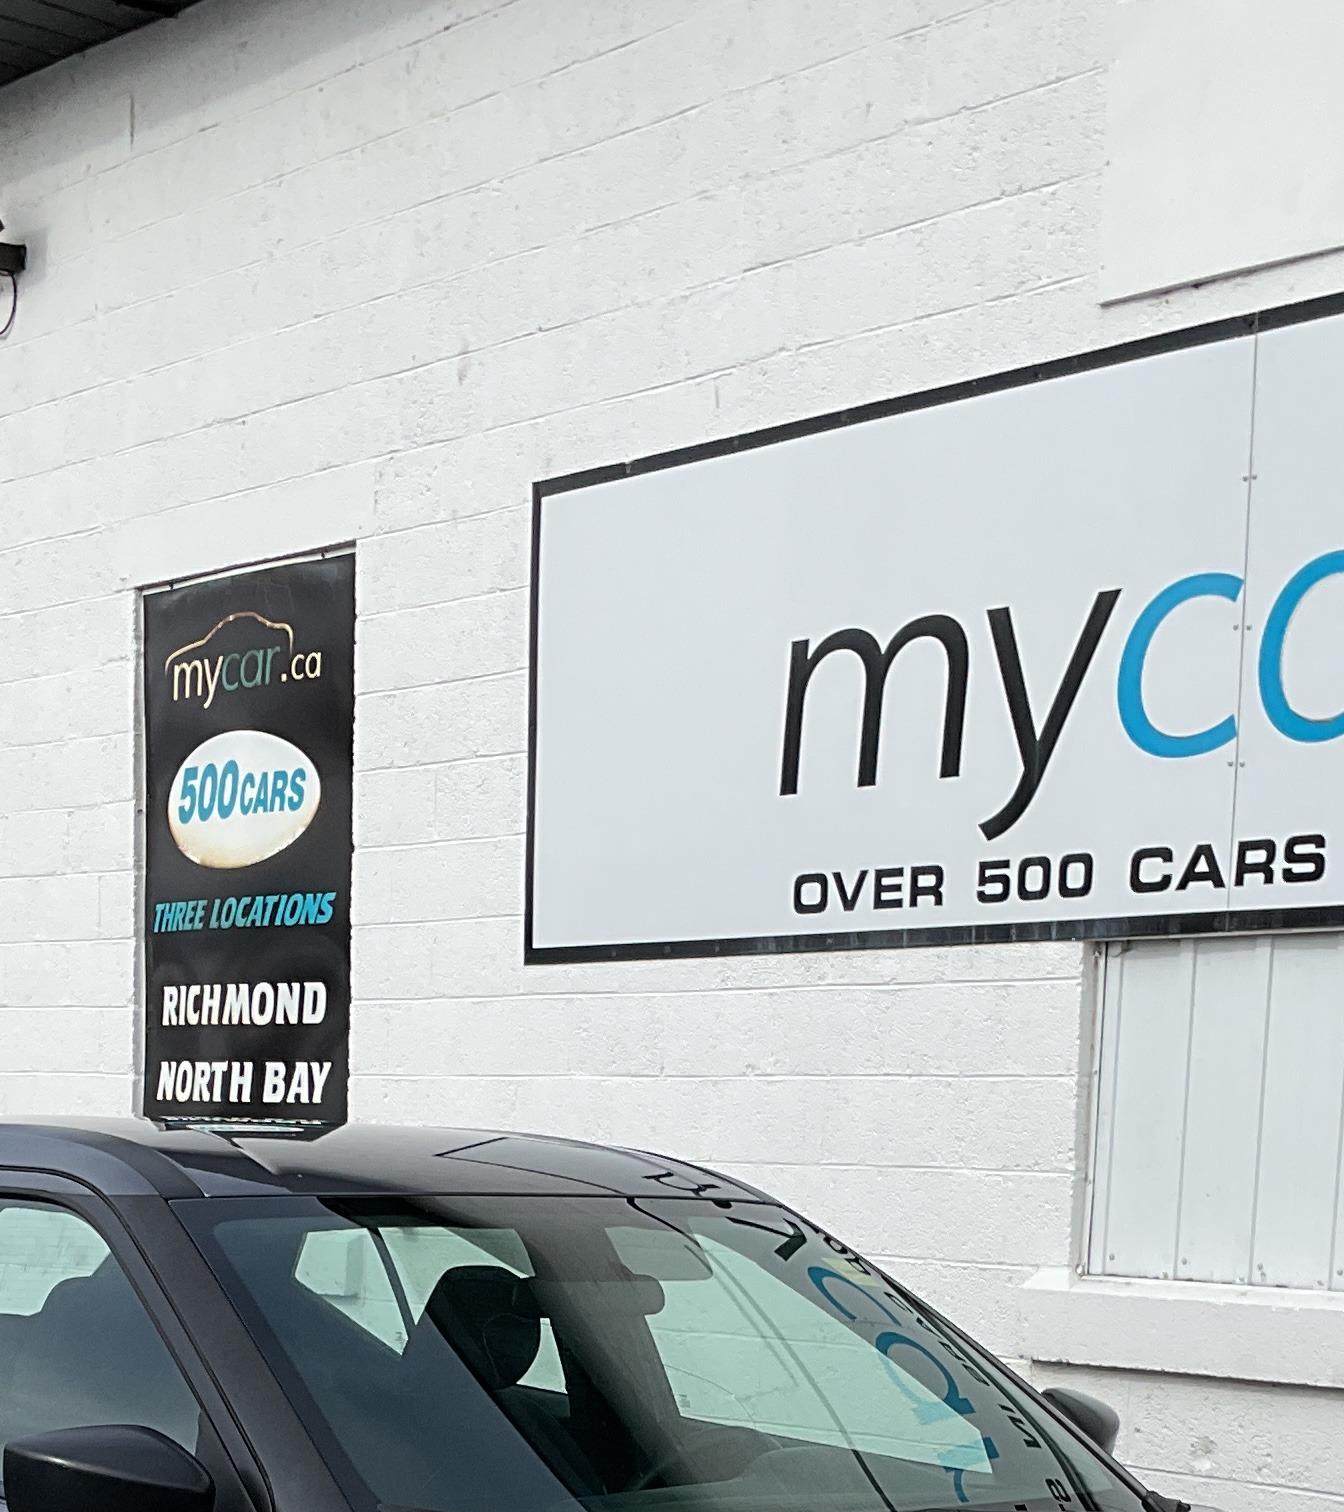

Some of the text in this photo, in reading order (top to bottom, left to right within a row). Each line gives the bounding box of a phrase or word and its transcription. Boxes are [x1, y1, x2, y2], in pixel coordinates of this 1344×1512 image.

[172, 645, 322, 710] mycar.ca
[792, 865, 945, 915] OVER
[976, 852, 1094, 904] 500
[1128, 834, 1327, 894] CARS
[153, 891, 337, 934] THREE LOCATIONS
[161, 981, 328, 1027] RICHMOND
[156, 1059, 333, 1105] NORTH BAY
